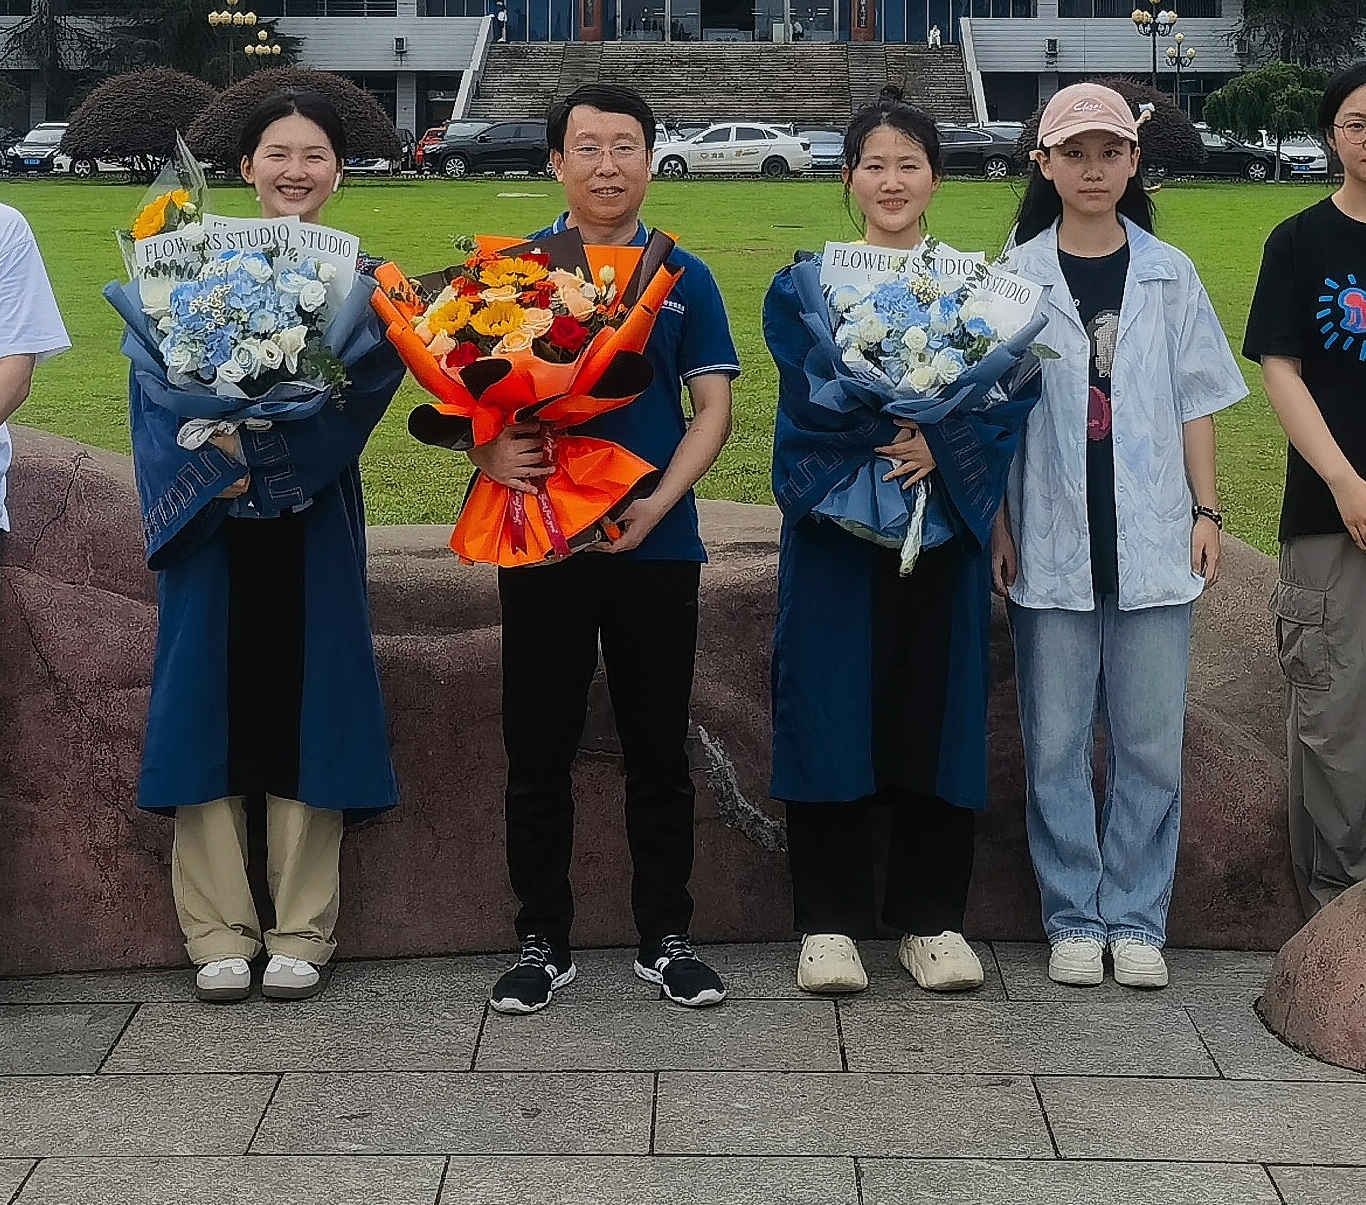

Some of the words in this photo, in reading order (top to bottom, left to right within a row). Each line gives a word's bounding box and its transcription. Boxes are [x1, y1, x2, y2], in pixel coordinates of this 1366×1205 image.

[145, 234, 222, 262] FLOWRS
[226, 223, 290, 250] STUDIO
[912, 257, 974, 276] SUDIO
